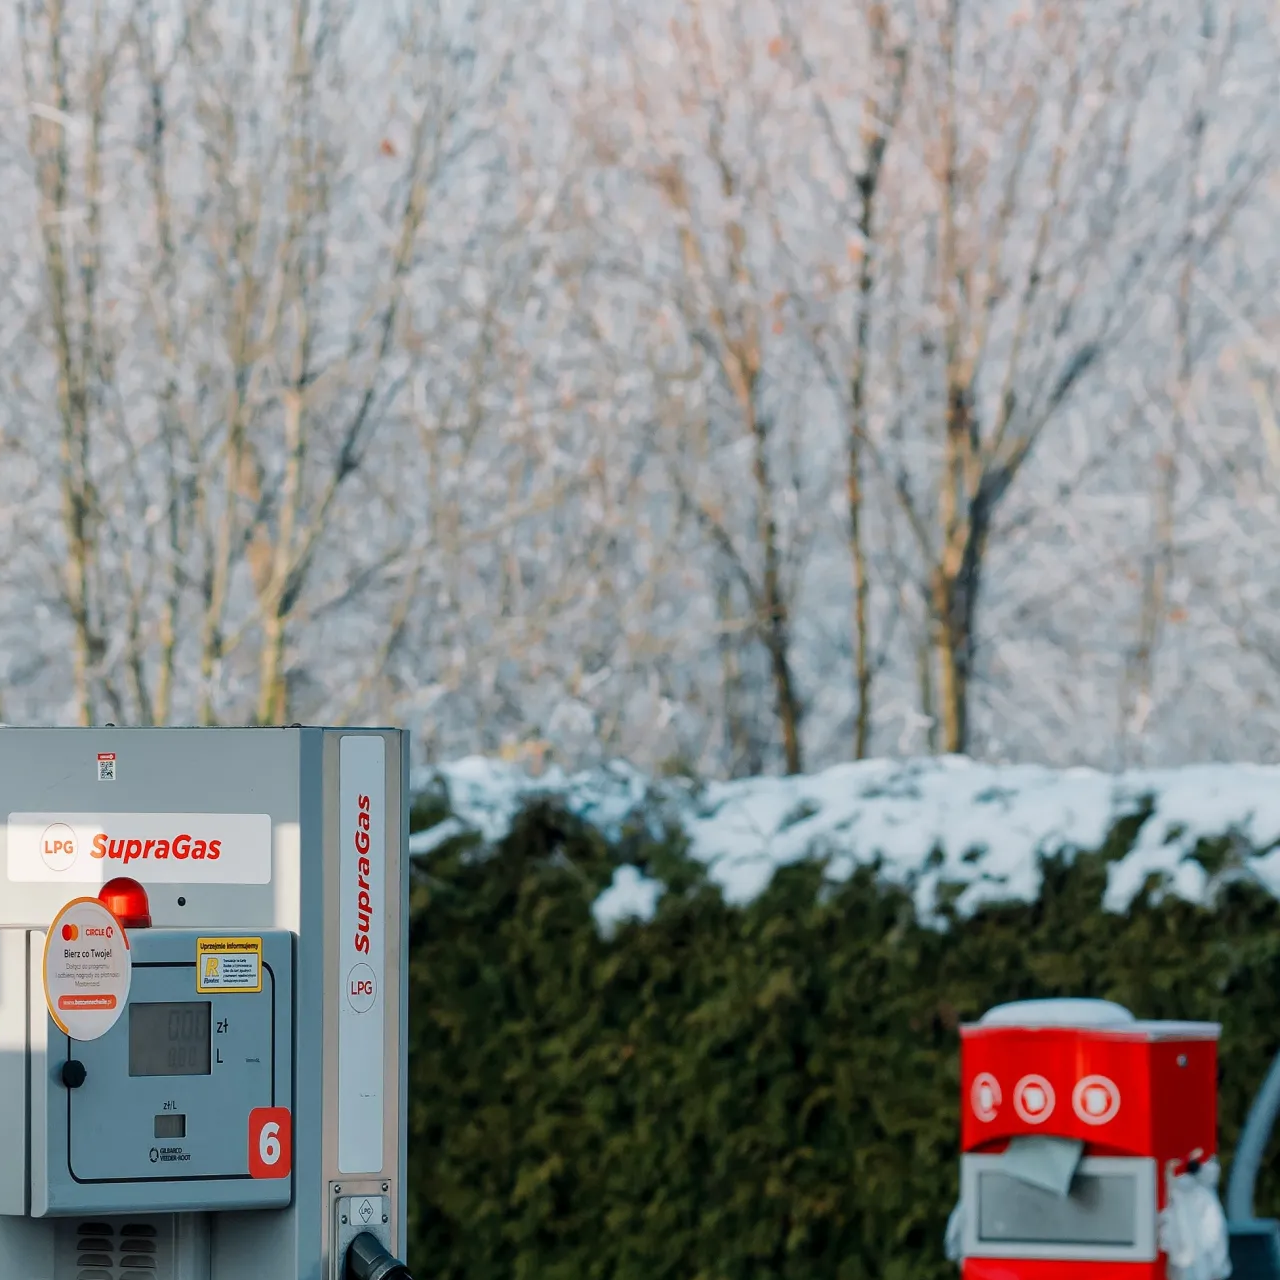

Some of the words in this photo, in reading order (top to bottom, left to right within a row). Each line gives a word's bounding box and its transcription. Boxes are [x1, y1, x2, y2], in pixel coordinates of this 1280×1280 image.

[45, 840, 73, 854] LPG
[90, 833, 221, 864] SupraGas
[354, 794, 372, 955] SupraGas
[227, 942, 258, 950] informujemy
[64, 949, 81, 958] Bierz
[91, 949, 112, 960] Twoje!
[351, 981, 372, 995] LPG
[217, 1018, 228, 1033] zł
[217, 1048, 223, 1063] L
[163, 1101, 177, 1110] zł/L
[259, 1121, 280, 1166] 6
